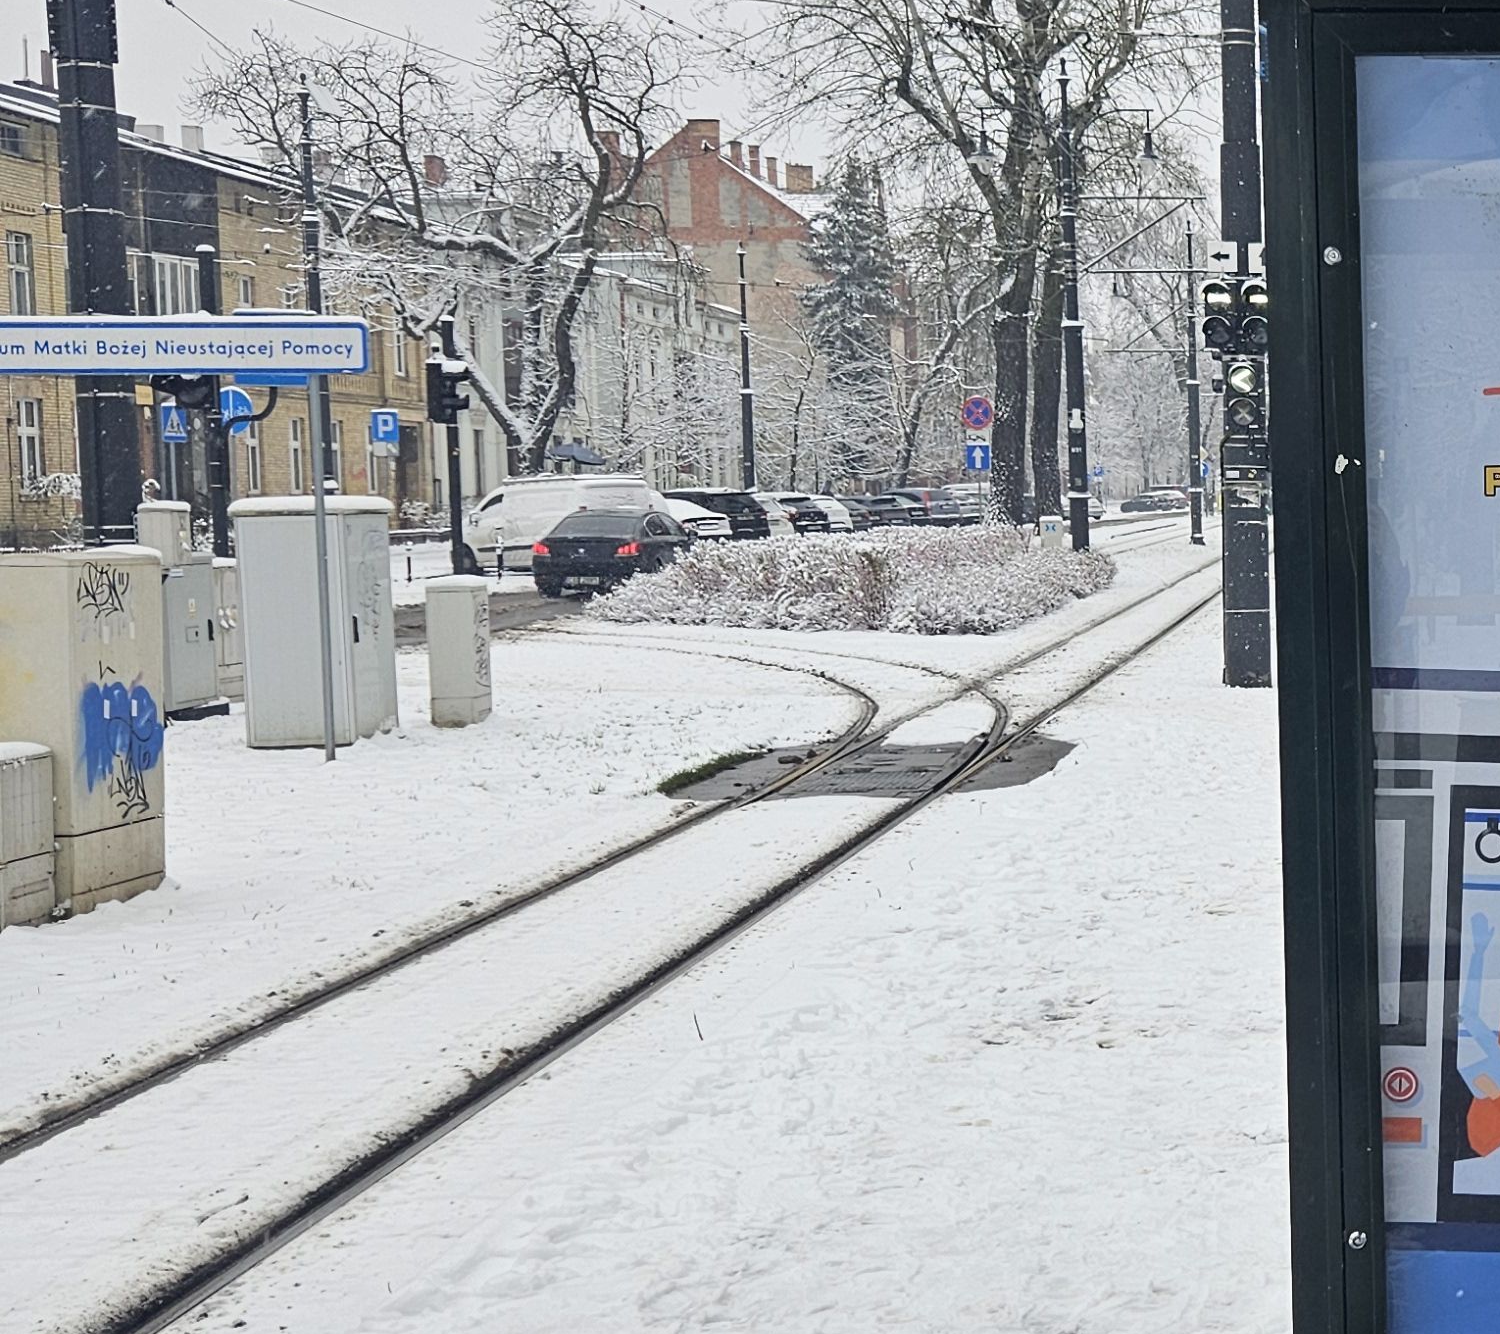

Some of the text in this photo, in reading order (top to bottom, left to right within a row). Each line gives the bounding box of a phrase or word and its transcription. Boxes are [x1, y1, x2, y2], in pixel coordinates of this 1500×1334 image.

[34, 340, 87, 355] Matki
[96, 340, 147, 358] Bożej
[156, 340, 274, 359] Nieustającej
[282, 340, 353, 359] Pomocy
[377, 414, 394, 438] P
